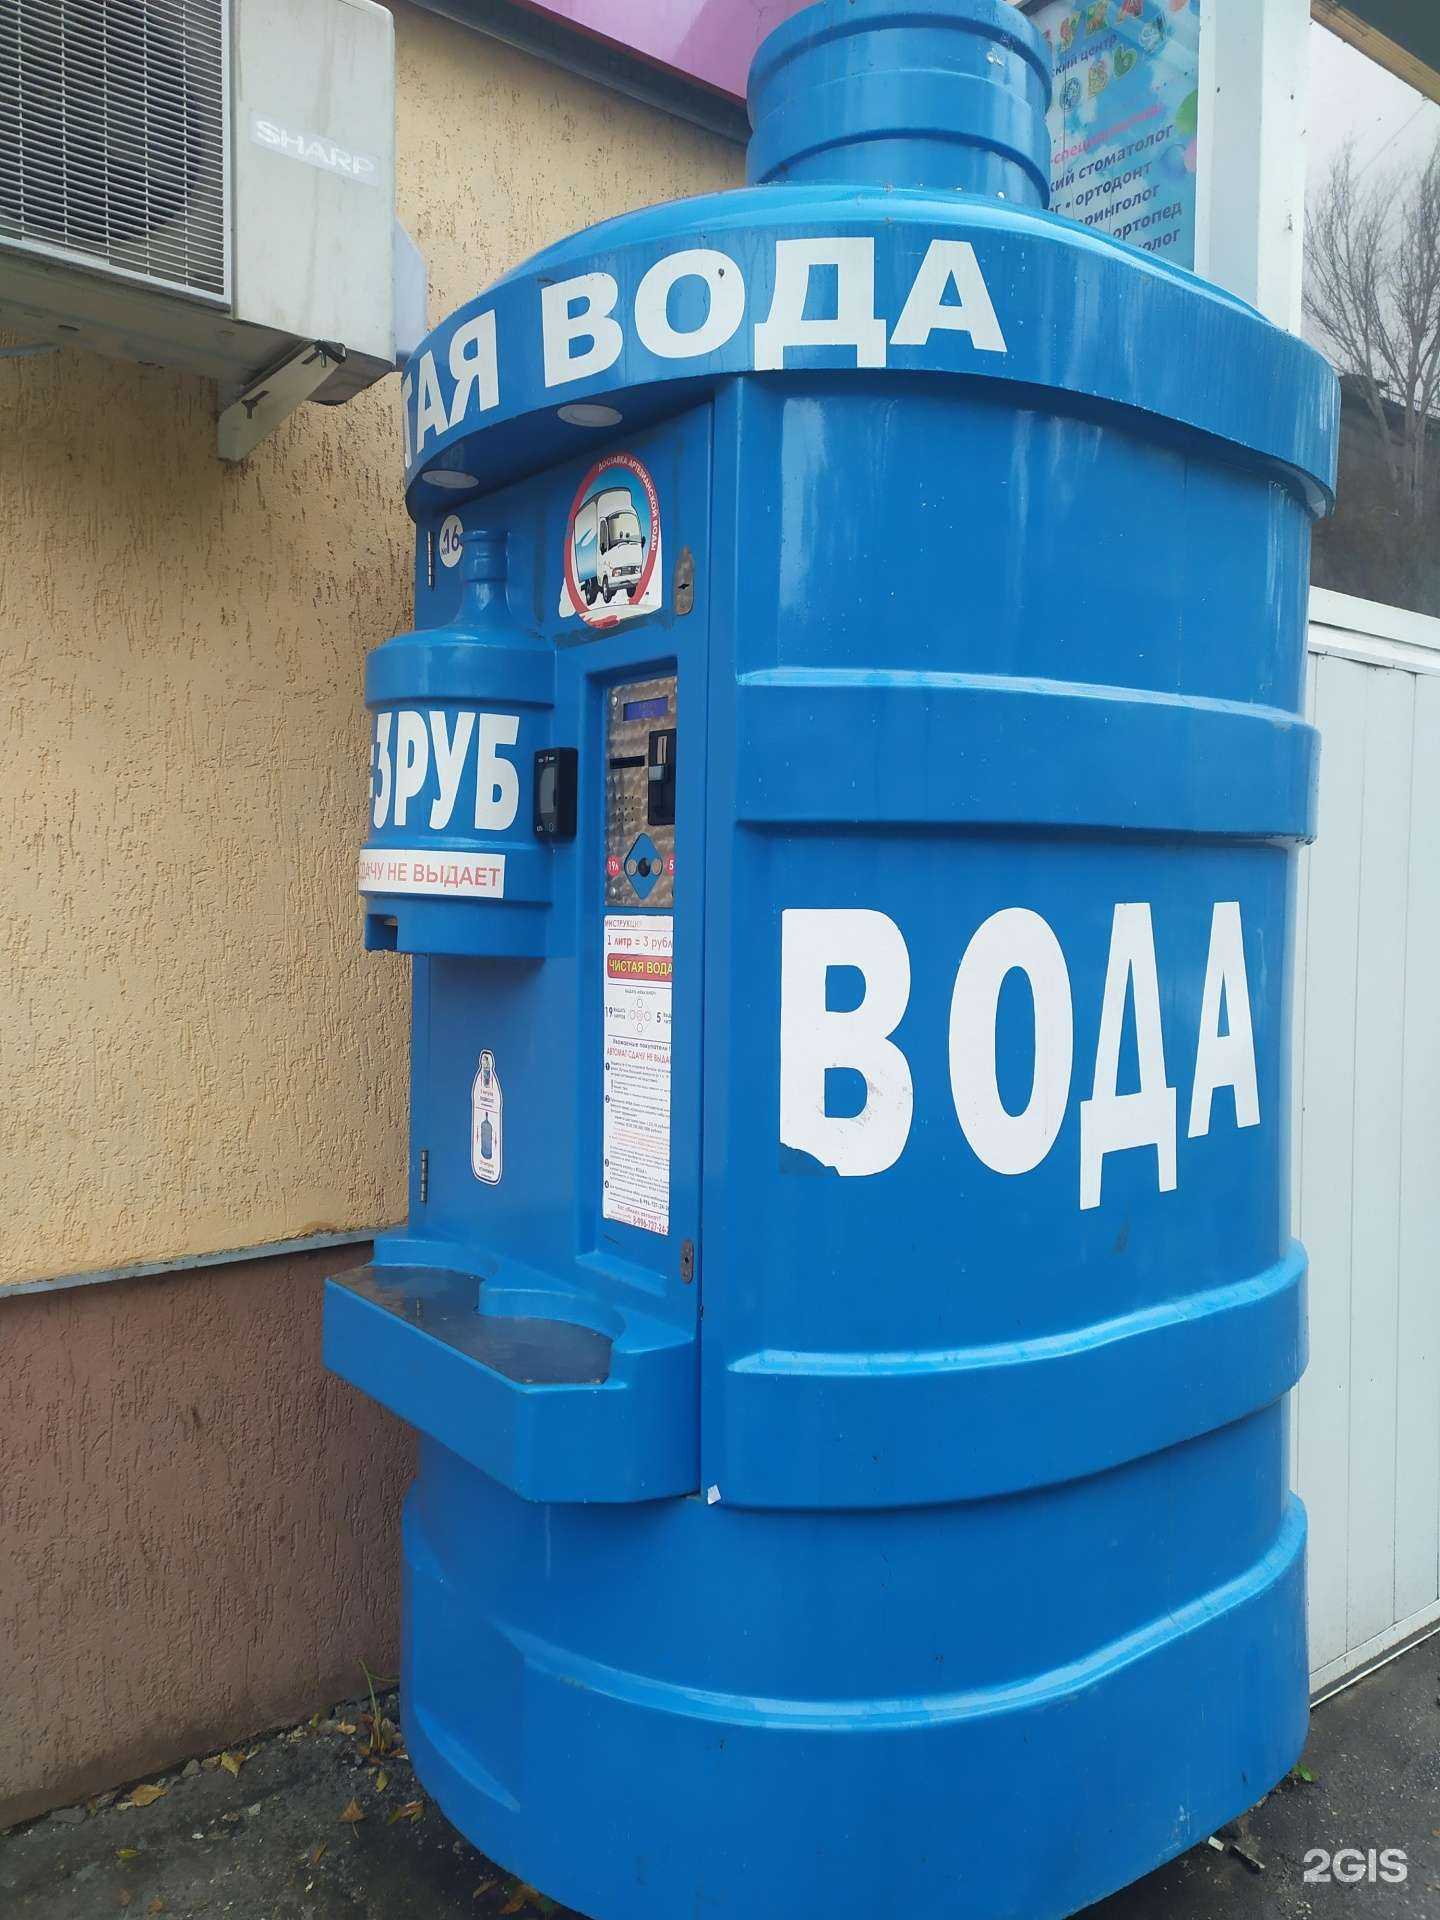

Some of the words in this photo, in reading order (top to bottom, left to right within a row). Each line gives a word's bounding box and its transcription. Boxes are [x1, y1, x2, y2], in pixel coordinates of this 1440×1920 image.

[255, 119, 375, 175] SHARP
[1079, 125, 1174, 180] стоматолог
[1076, 162, 1152, 206] ортодонт
[1078, 184, 1160, 226] ринголог
[1112, 202, 1183, 240] ортопед
[1139, 228, 1181, 251] олог
[541, 237, 1008, 388] ВОДА
[369, 710, 520, 831] 3РУБ
[359, 861, 385, 881] ДАЧУ
[387, 862, 408, 882] НЕ
[412, 863, 501, 888] ВЫДАЕТ
[614, 937, 632, 949] литр
[643, 936, 649, 947] 3
[609, 959, 644, 973] ЧИСТАЯ
[646, 961, 673, 976] ВОДА
[780, 901, 1260, 1211] ВОДА
